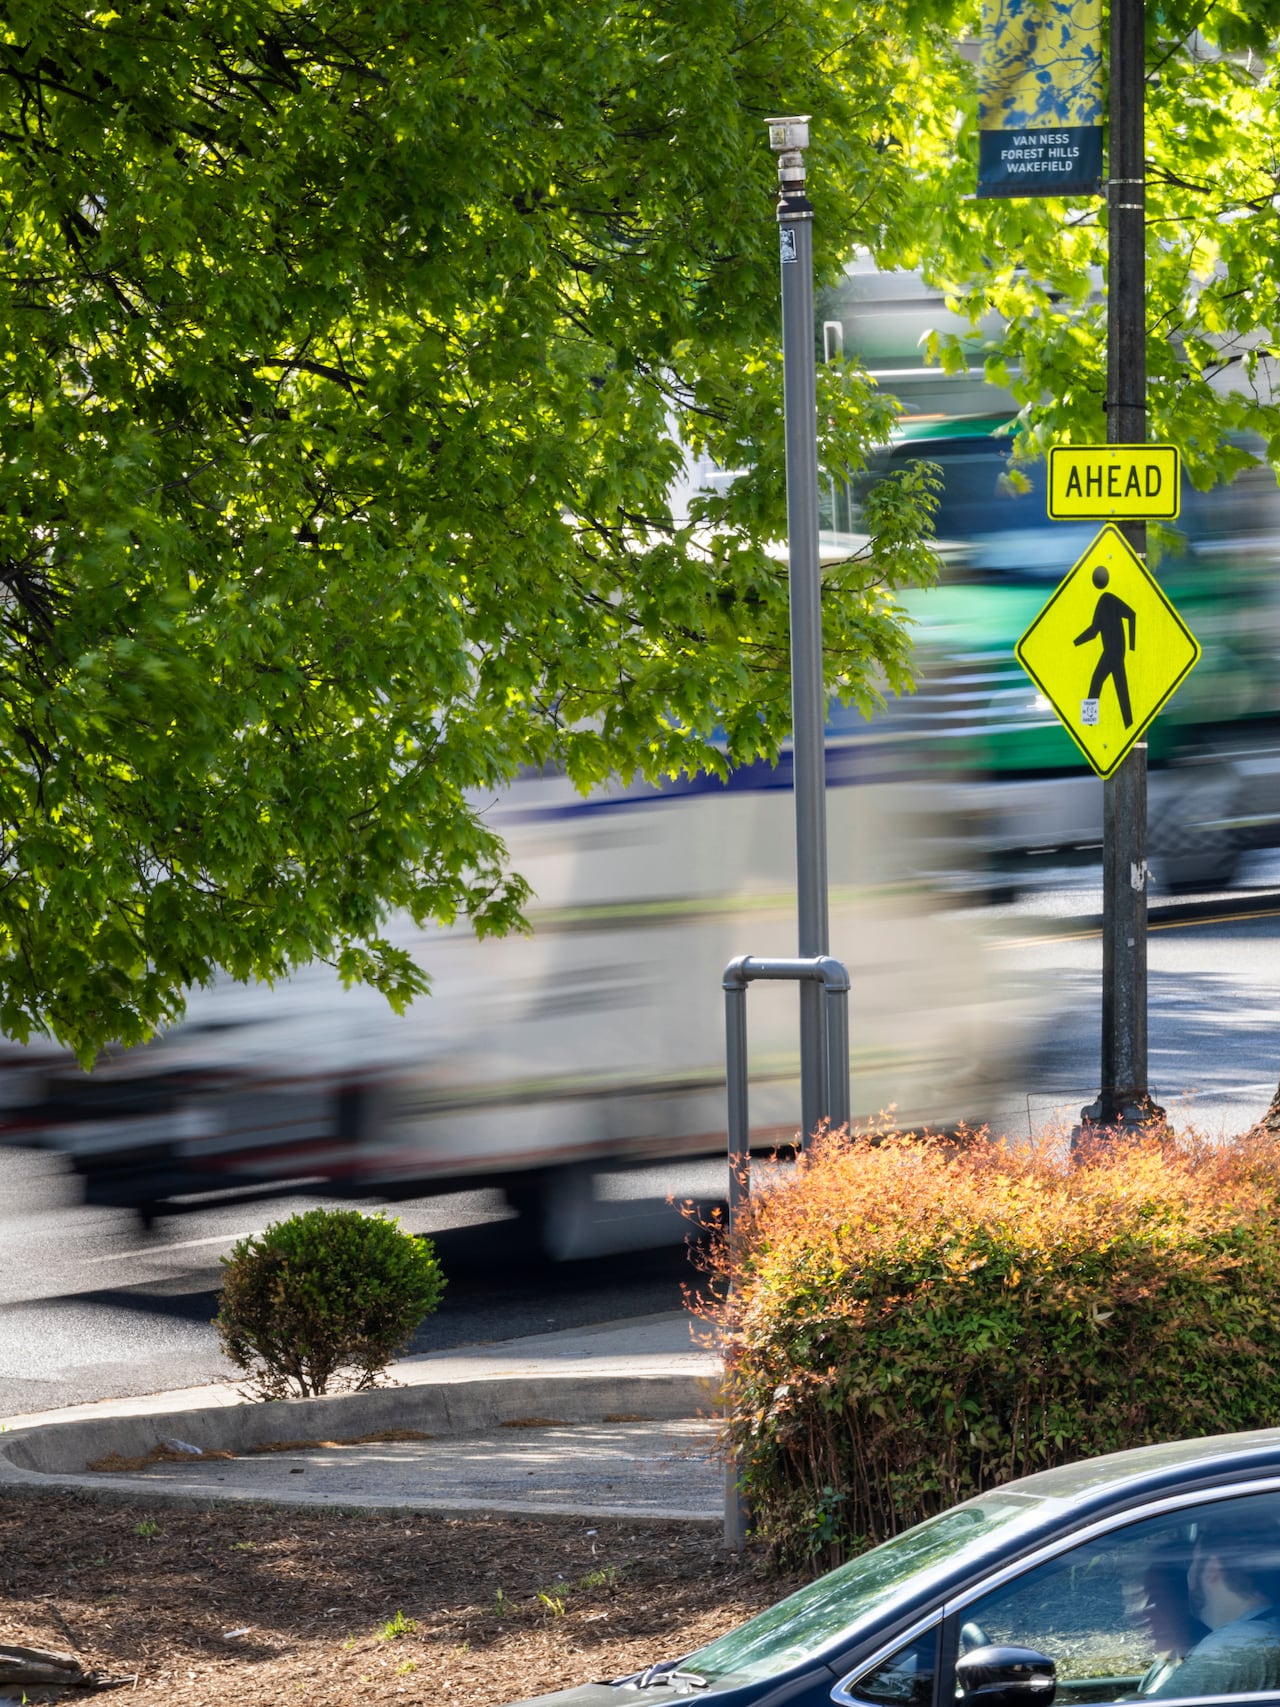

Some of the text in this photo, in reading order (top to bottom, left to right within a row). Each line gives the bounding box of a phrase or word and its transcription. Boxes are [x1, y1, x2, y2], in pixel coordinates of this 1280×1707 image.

[1013, 133, 1069, 146] VAN NESS
[1001, 146, 1080, 160] FOREST HILLS
[1006, 160, 1073, 173] WAKEFIELD
[1065, 464, 1162, 498] AHEAD
